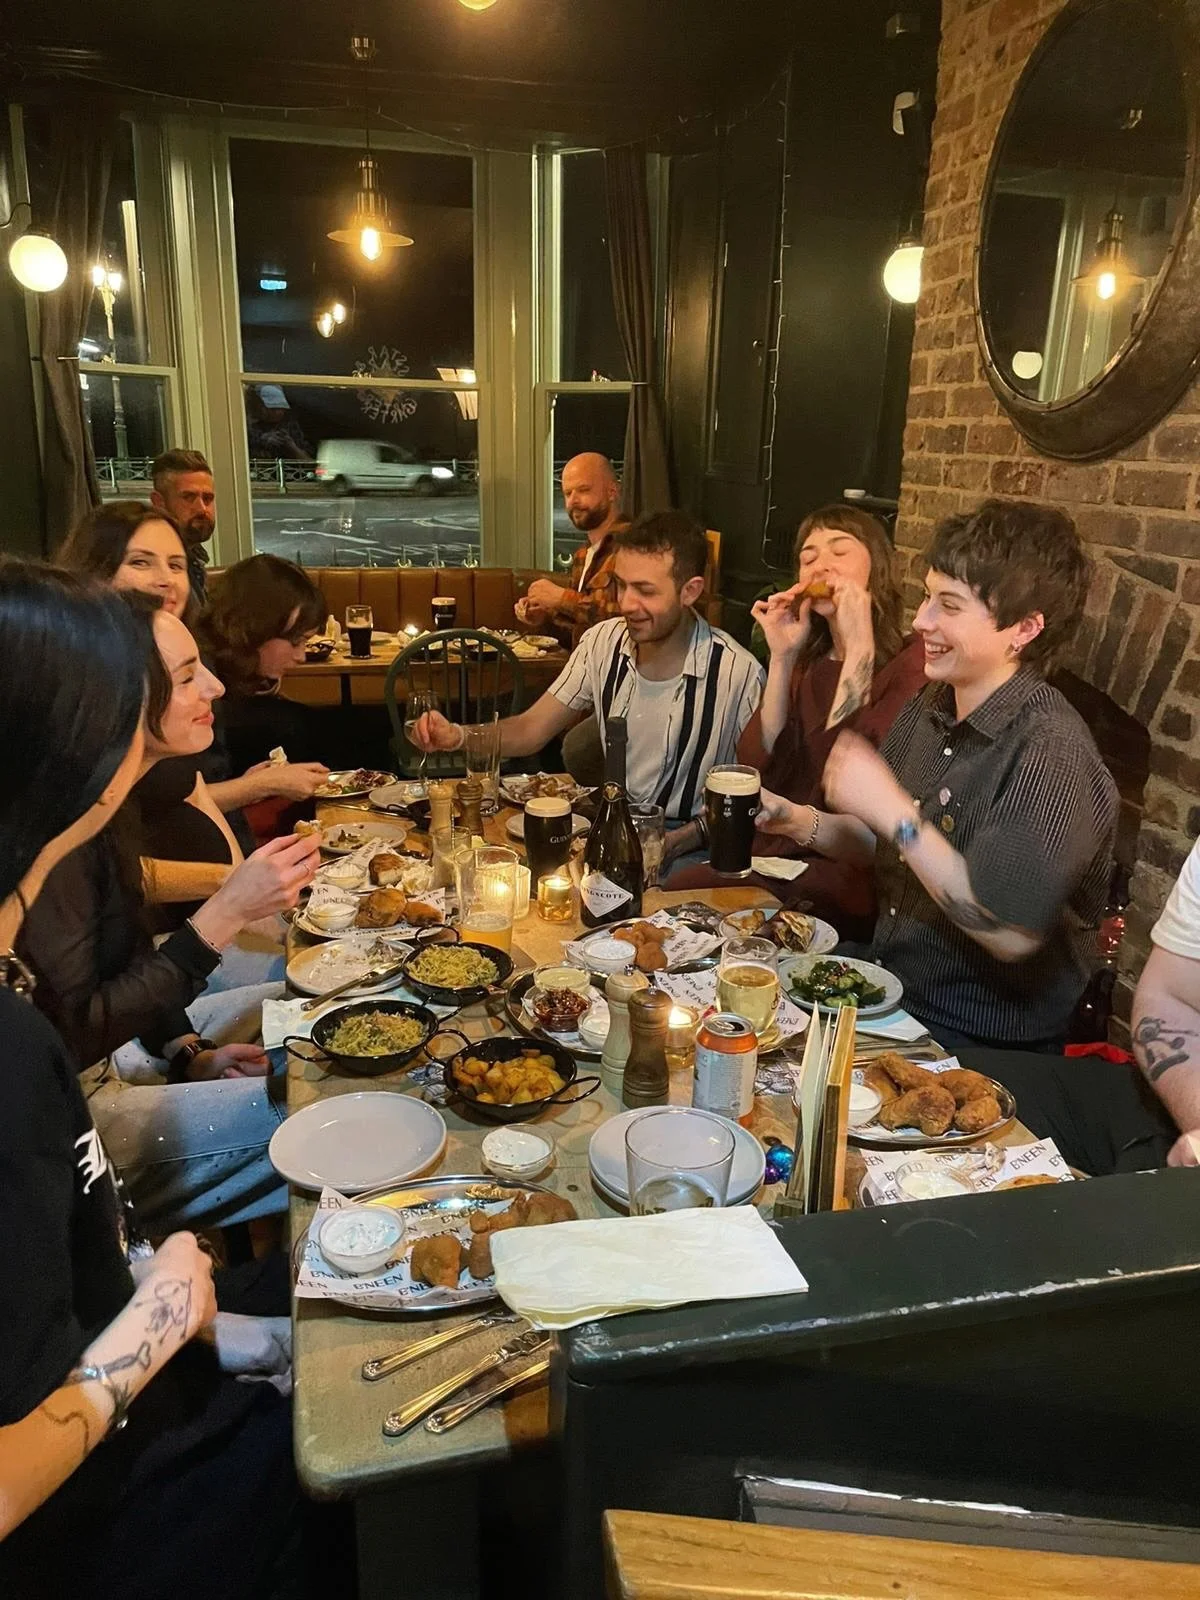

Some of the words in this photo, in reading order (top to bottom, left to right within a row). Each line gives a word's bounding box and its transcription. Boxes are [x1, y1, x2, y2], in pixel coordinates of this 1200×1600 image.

[1010, 1143, 1046, 1170] B'NEEN
[319, 1197, 342, 1210] EEN
[353, 1273, 403, 1290] B'NEEN
